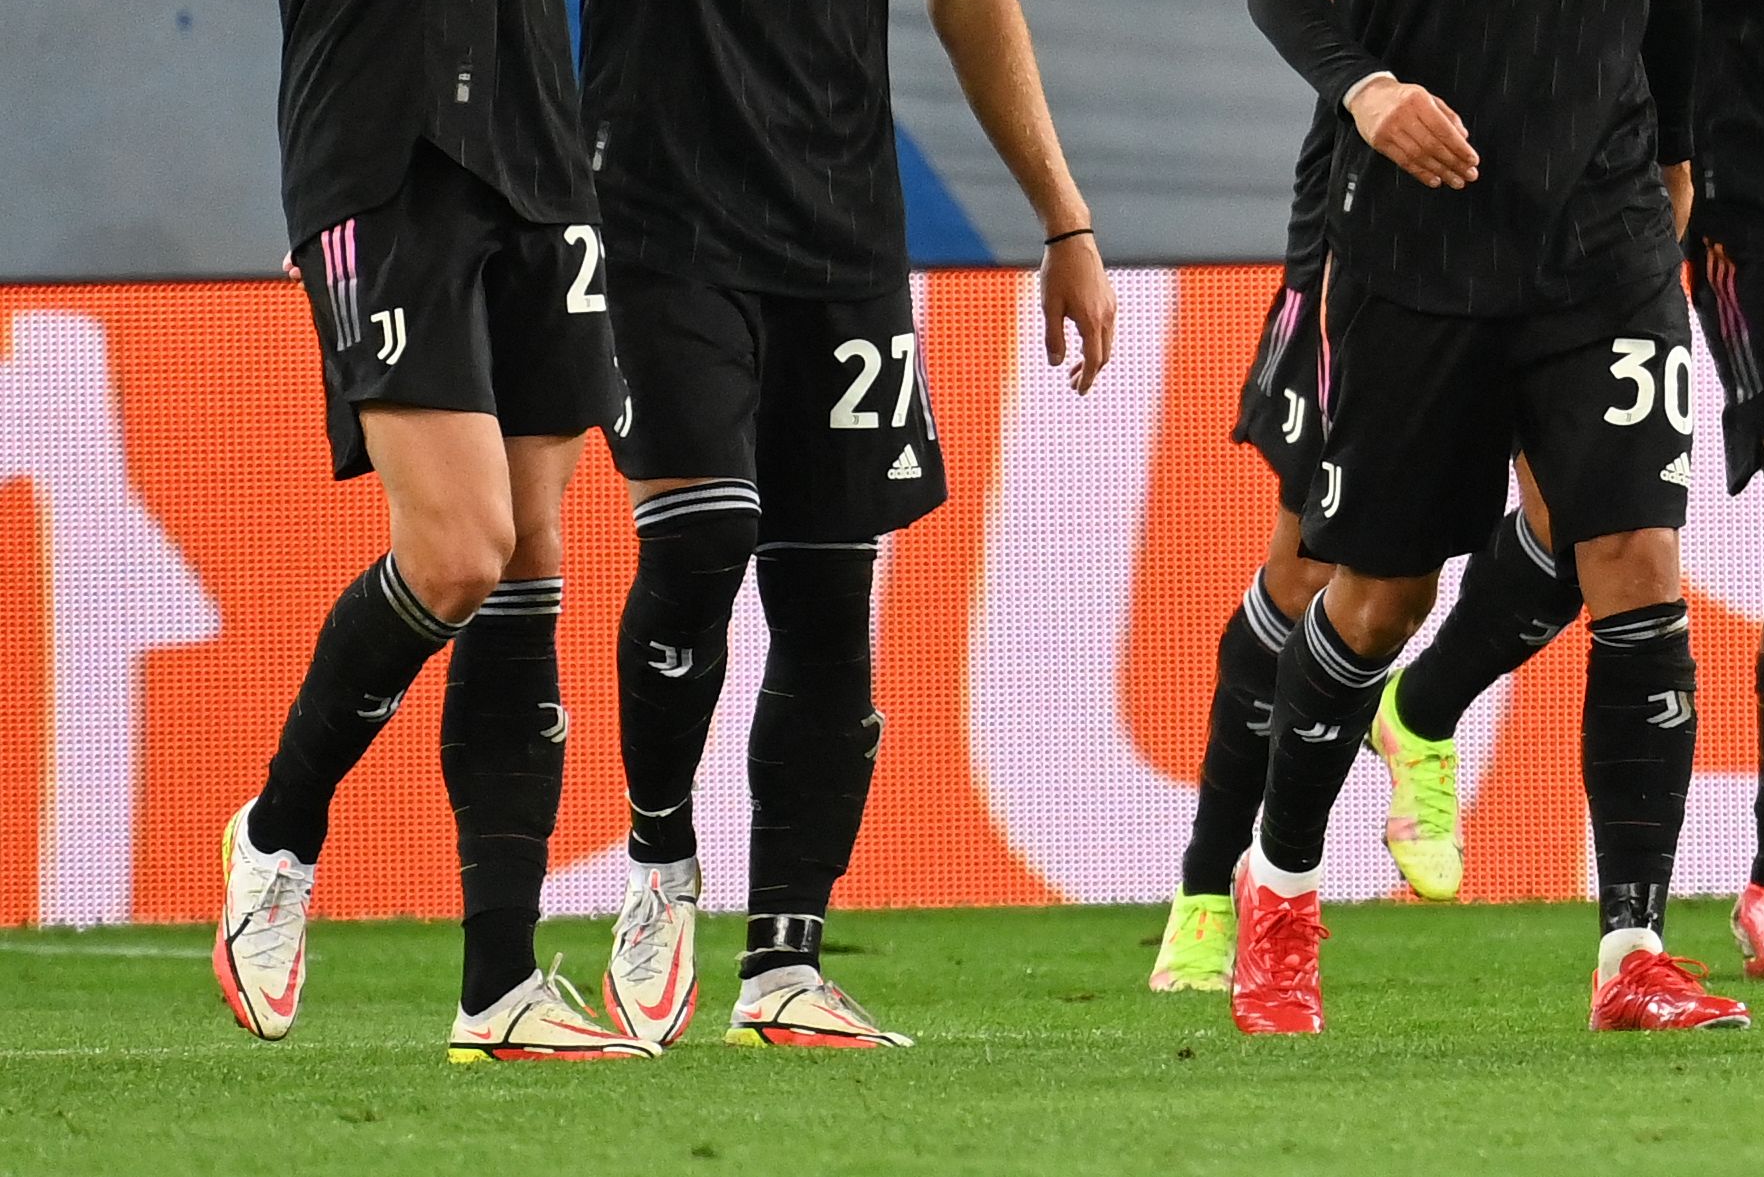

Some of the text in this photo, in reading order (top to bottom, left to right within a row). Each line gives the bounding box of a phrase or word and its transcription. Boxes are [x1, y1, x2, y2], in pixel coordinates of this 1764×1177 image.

[562, 224, 606, 314] 2
[830, 333, 914, 429] 27
[1603, 338, 1692, 436] 30
